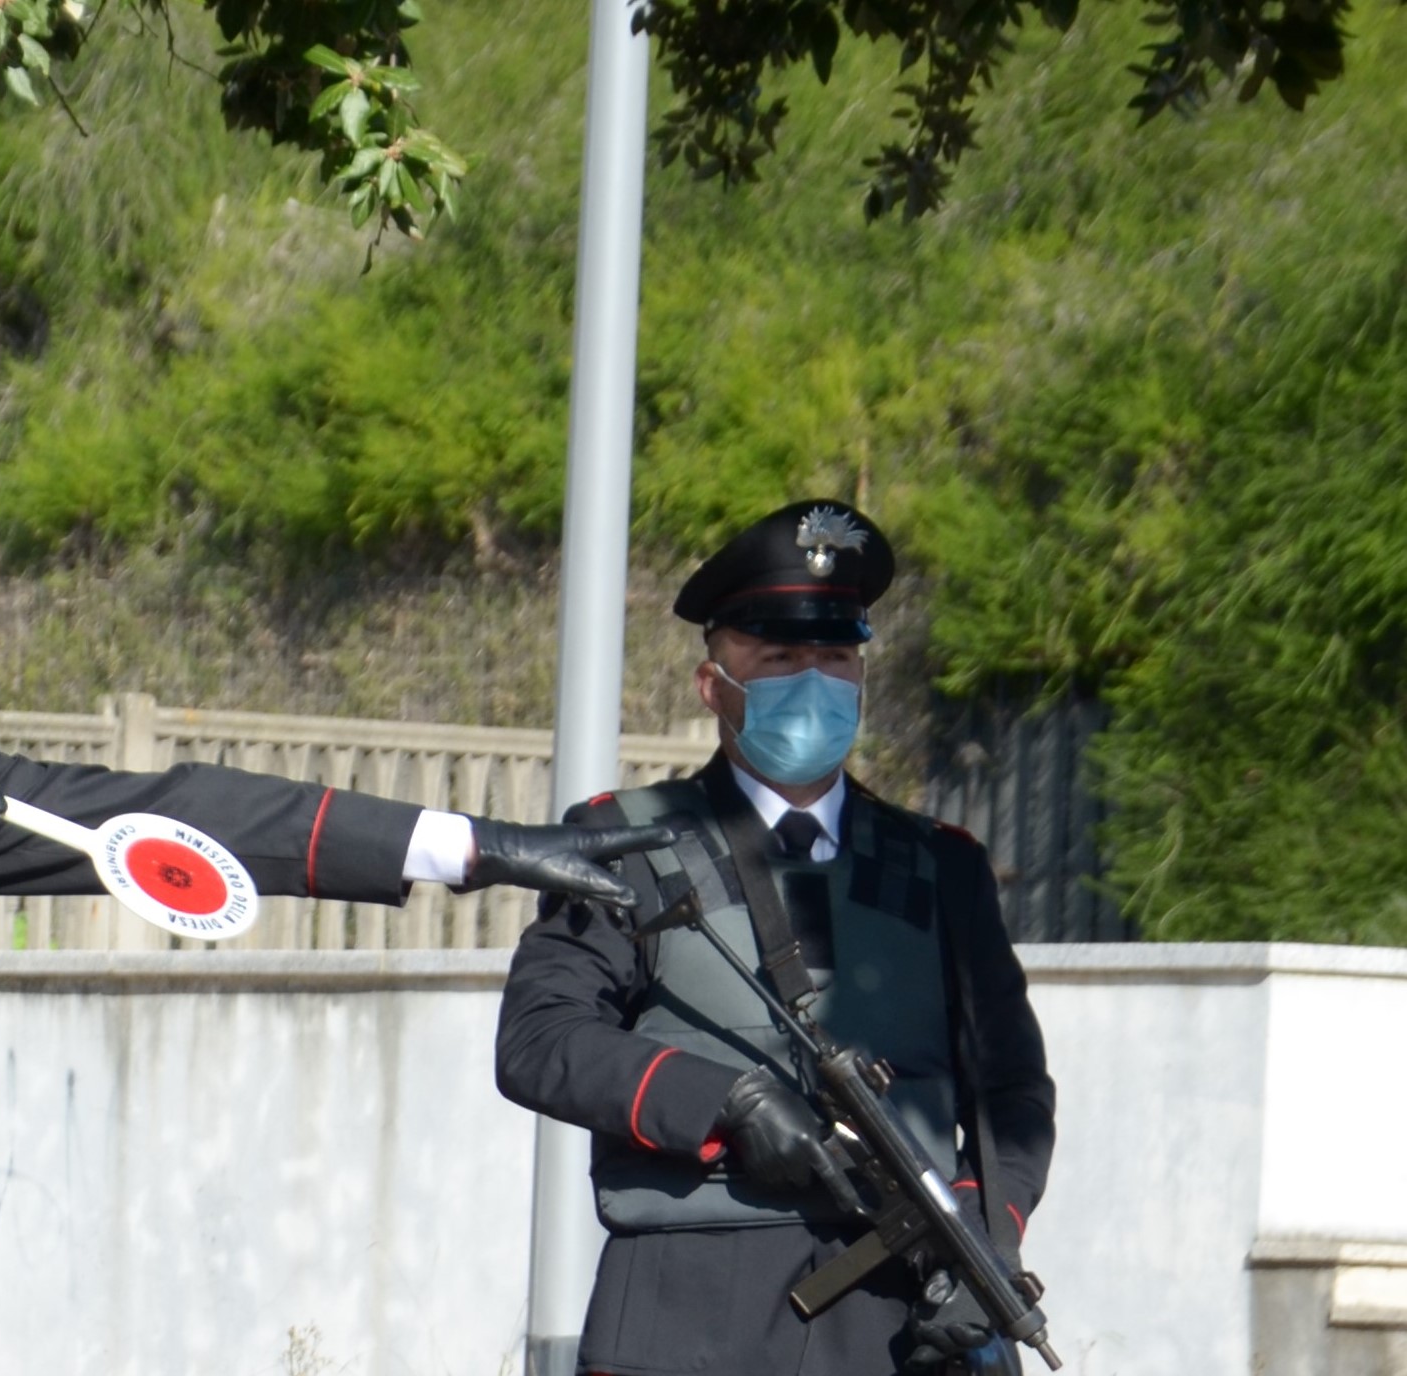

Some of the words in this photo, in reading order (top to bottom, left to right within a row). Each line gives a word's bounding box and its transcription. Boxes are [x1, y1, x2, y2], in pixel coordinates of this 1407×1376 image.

[106, 825, 136, 888] CARABINIERI
[175, 829, 245, 889] MINISTERO
[169, 913, 223, 930] DIFESA
[225, 895, 247, 923] DELLA
